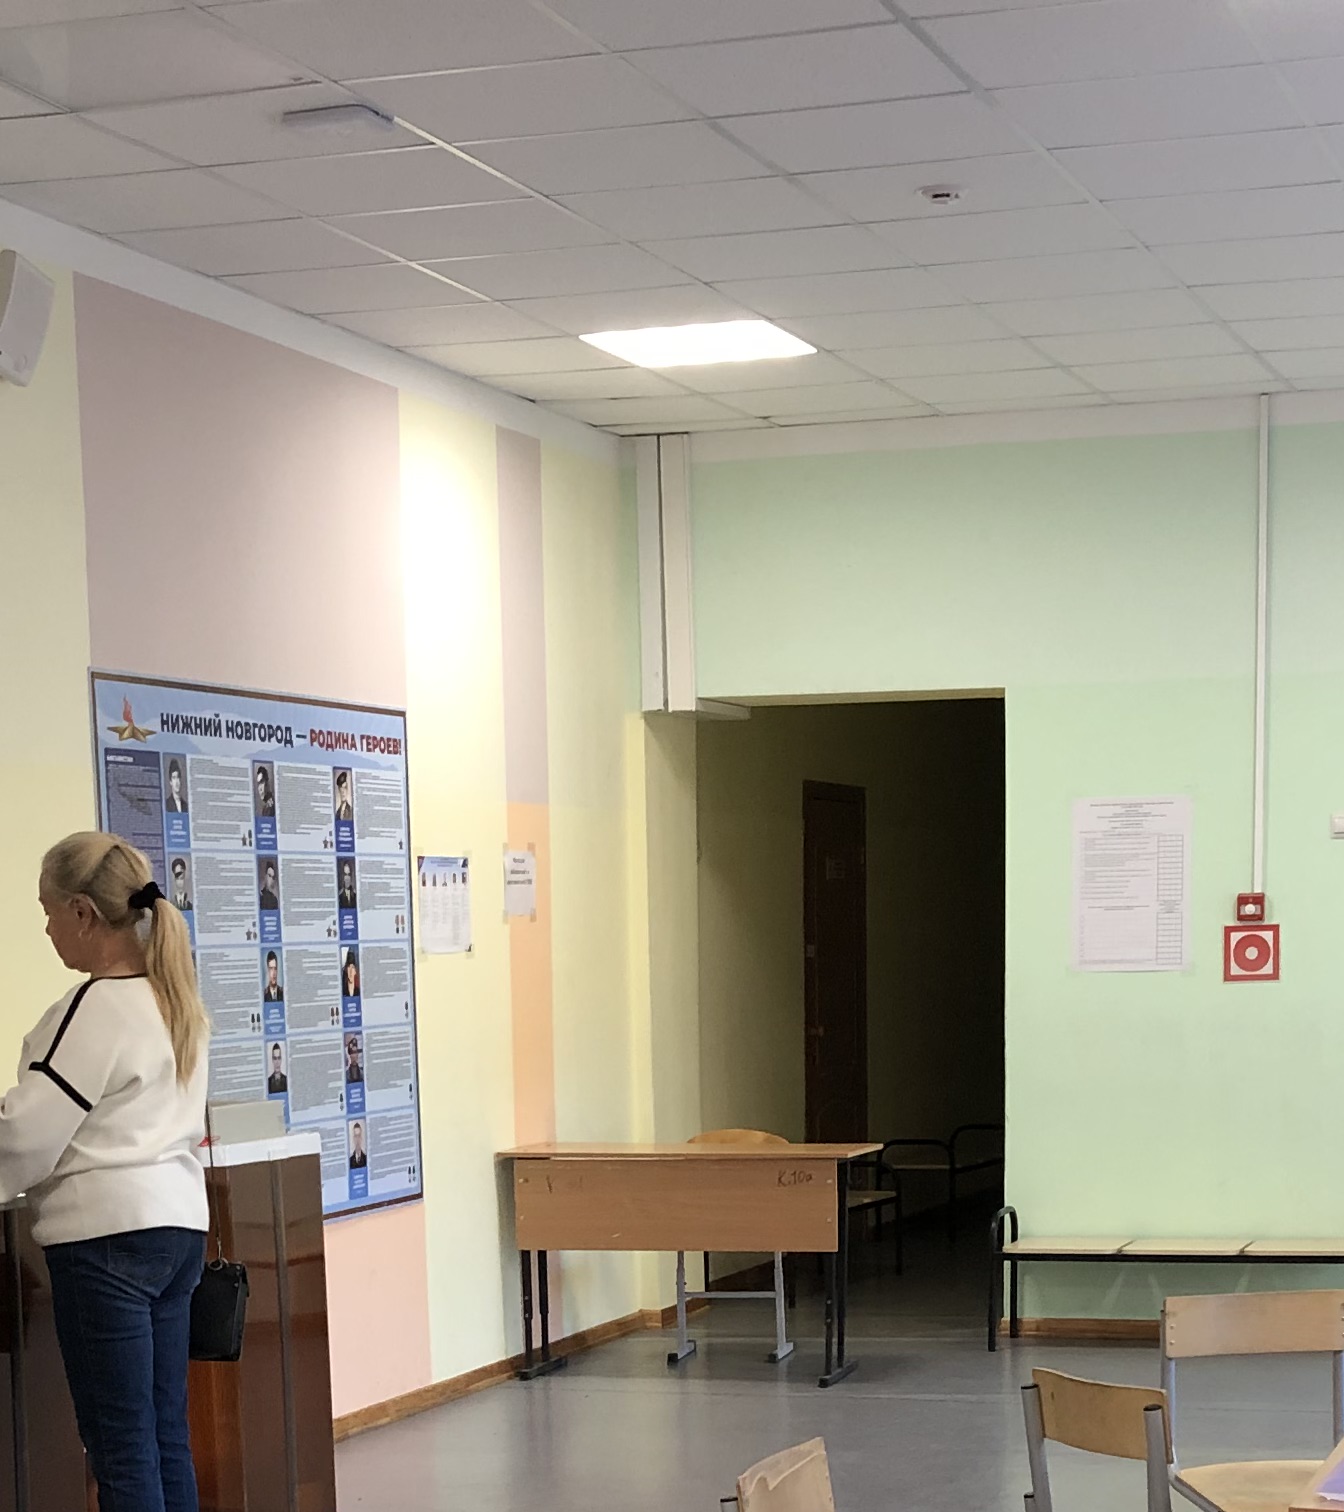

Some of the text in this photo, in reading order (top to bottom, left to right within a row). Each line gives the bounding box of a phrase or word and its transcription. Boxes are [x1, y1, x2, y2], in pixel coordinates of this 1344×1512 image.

[160, 712, 223, 738] НИЖНИЙ
[225, 719, 294, 748] НОВГОРОД
[309, 728, 358, 752] РОДИНА
[359, 734, 403, 756] ГЕРОЕВ!
